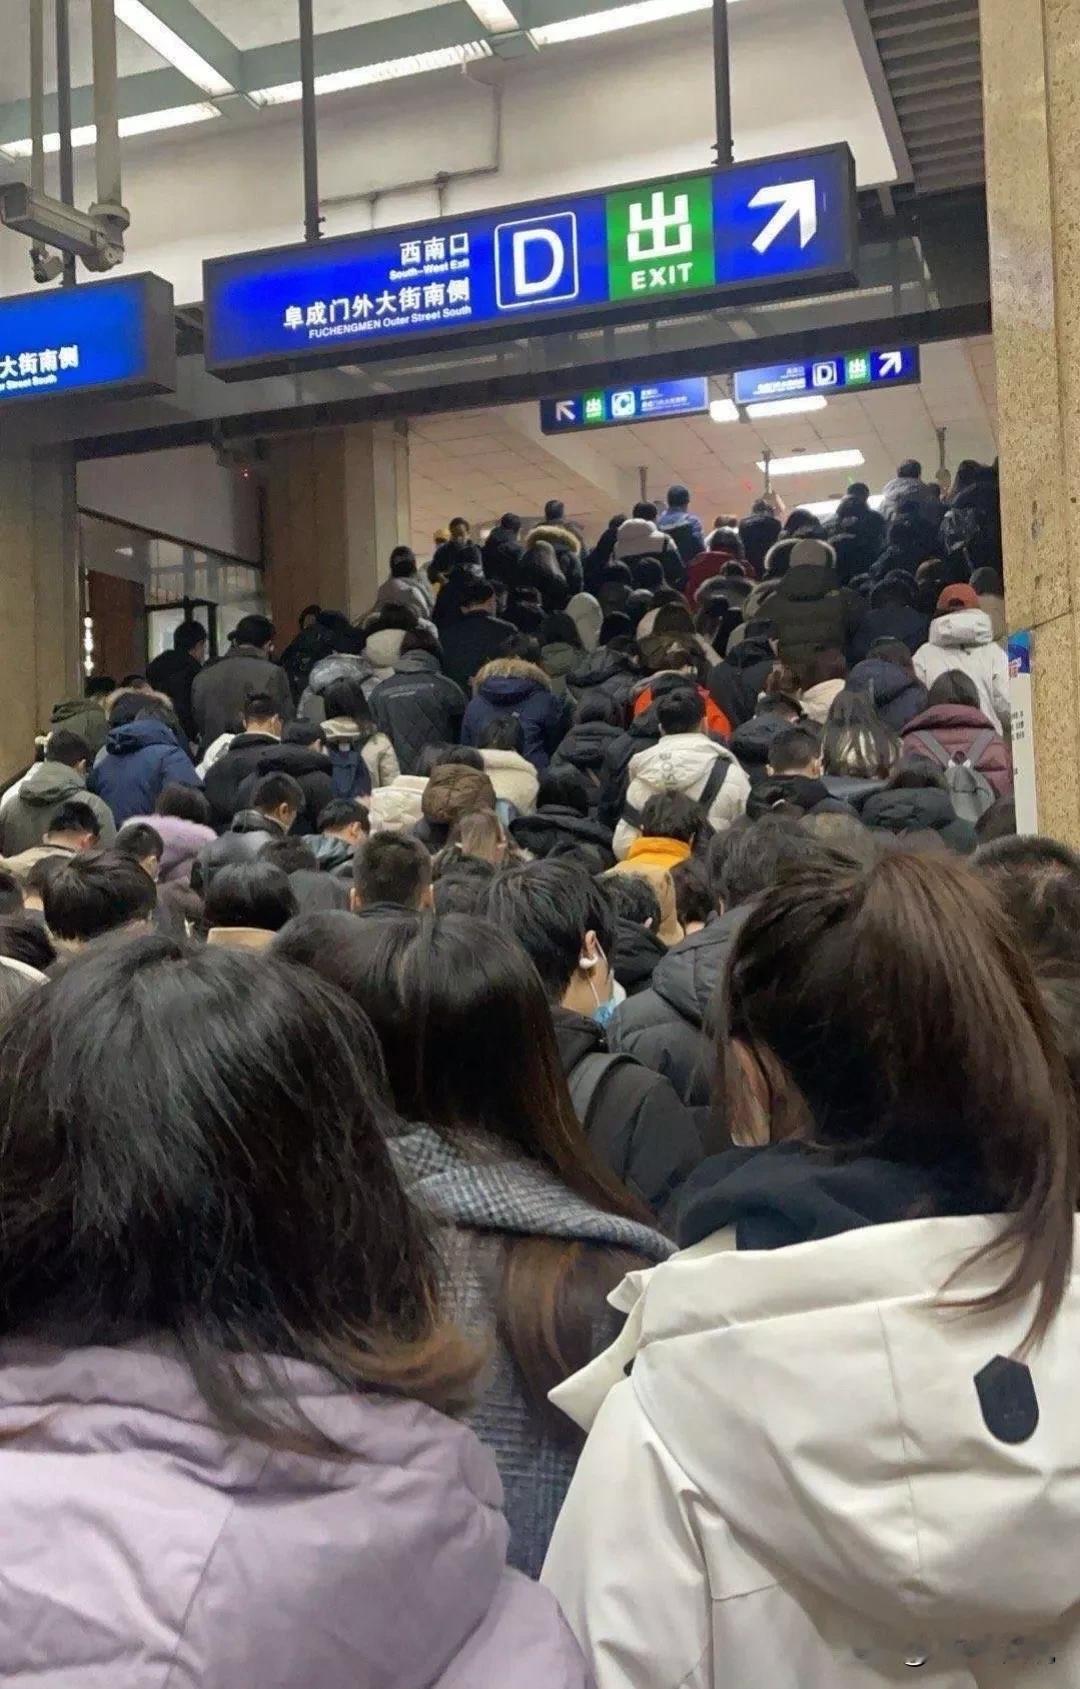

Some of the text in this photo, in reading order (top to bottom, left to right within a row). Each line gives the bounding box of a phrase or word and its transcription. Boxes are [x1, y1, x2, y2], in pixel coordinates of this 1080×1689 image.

[627, 191, 693, 262] 出
[399, 232, 470, 266] 西南口
[513, 228, 564, 295] D
[631, 262, 693, 291] EXIT
[283, 276, 470, 330] 阜成门外大街南侧
[308, 305, 472, 339] FUCHENGMEN Outer Street South
[0, 344, 79, 379] 大街南侧
[816, 365, 833, 385] D
